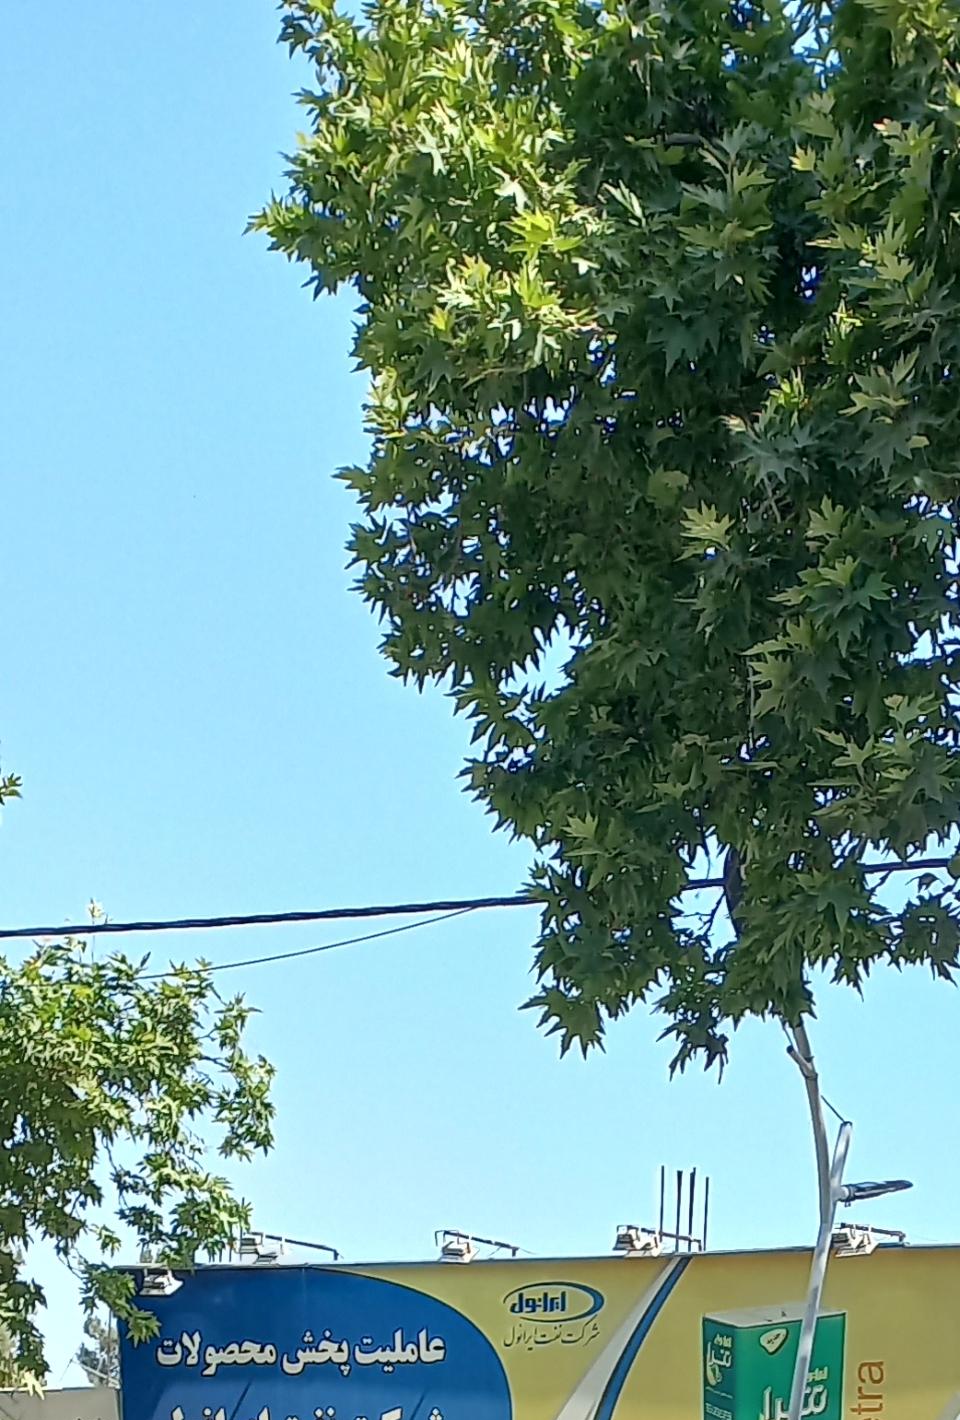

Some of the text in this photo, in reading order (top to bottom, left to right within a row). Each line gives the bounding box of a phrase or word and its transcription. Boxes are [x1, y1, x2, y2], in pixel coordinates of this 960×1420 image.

[156, 1328, 446, 1376] عاملیت پخش محصولات
[503, 1314, 600, 1350] شرکت نفت ایرانول
